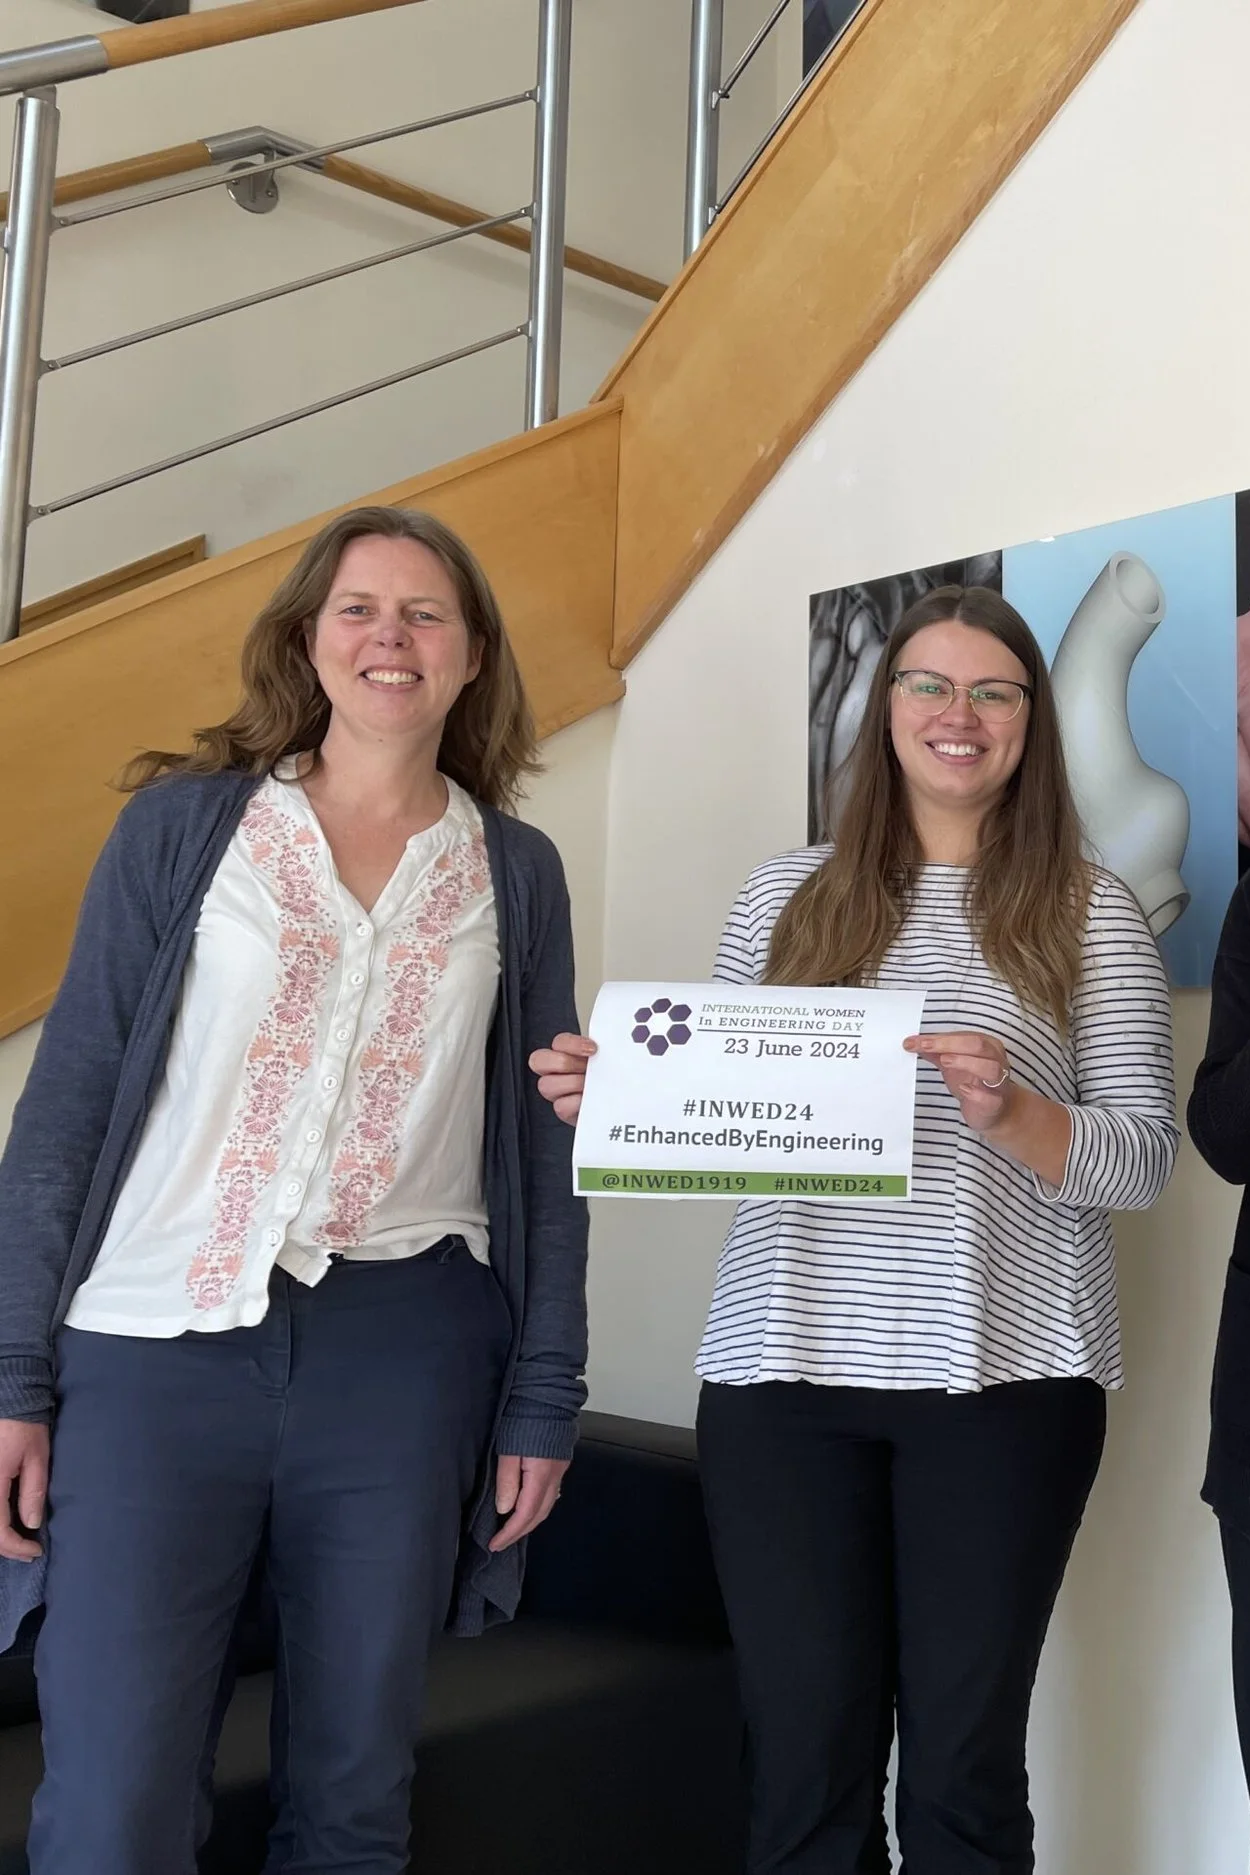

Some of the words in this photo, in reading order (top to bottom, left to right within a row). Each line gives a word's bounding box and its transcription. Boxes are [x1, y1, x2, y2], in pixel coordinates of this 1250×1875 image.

[701, 1003, 809, 1017] INTERNATIONAL
[812, 1008, 866, 1018] WOMEN
[698, 1016, 713, 1027] In
[719, 1017, 826, 1030] ENGINEERING
[831, 1021, 864, 1032] DAY
[724, 1038, 749, 1054] 23
[755, 1039, 803, 1057] June
[809, 1041, 860, 1059] 2024
[682, 1099, 814, 1121] #INWED24
[608, 1124, 884, 1155] #EnhancedByEngineering
[602, 1173, 747, 1191] @INWED1919
[774, 1178, 884, 1193] #INWED24
